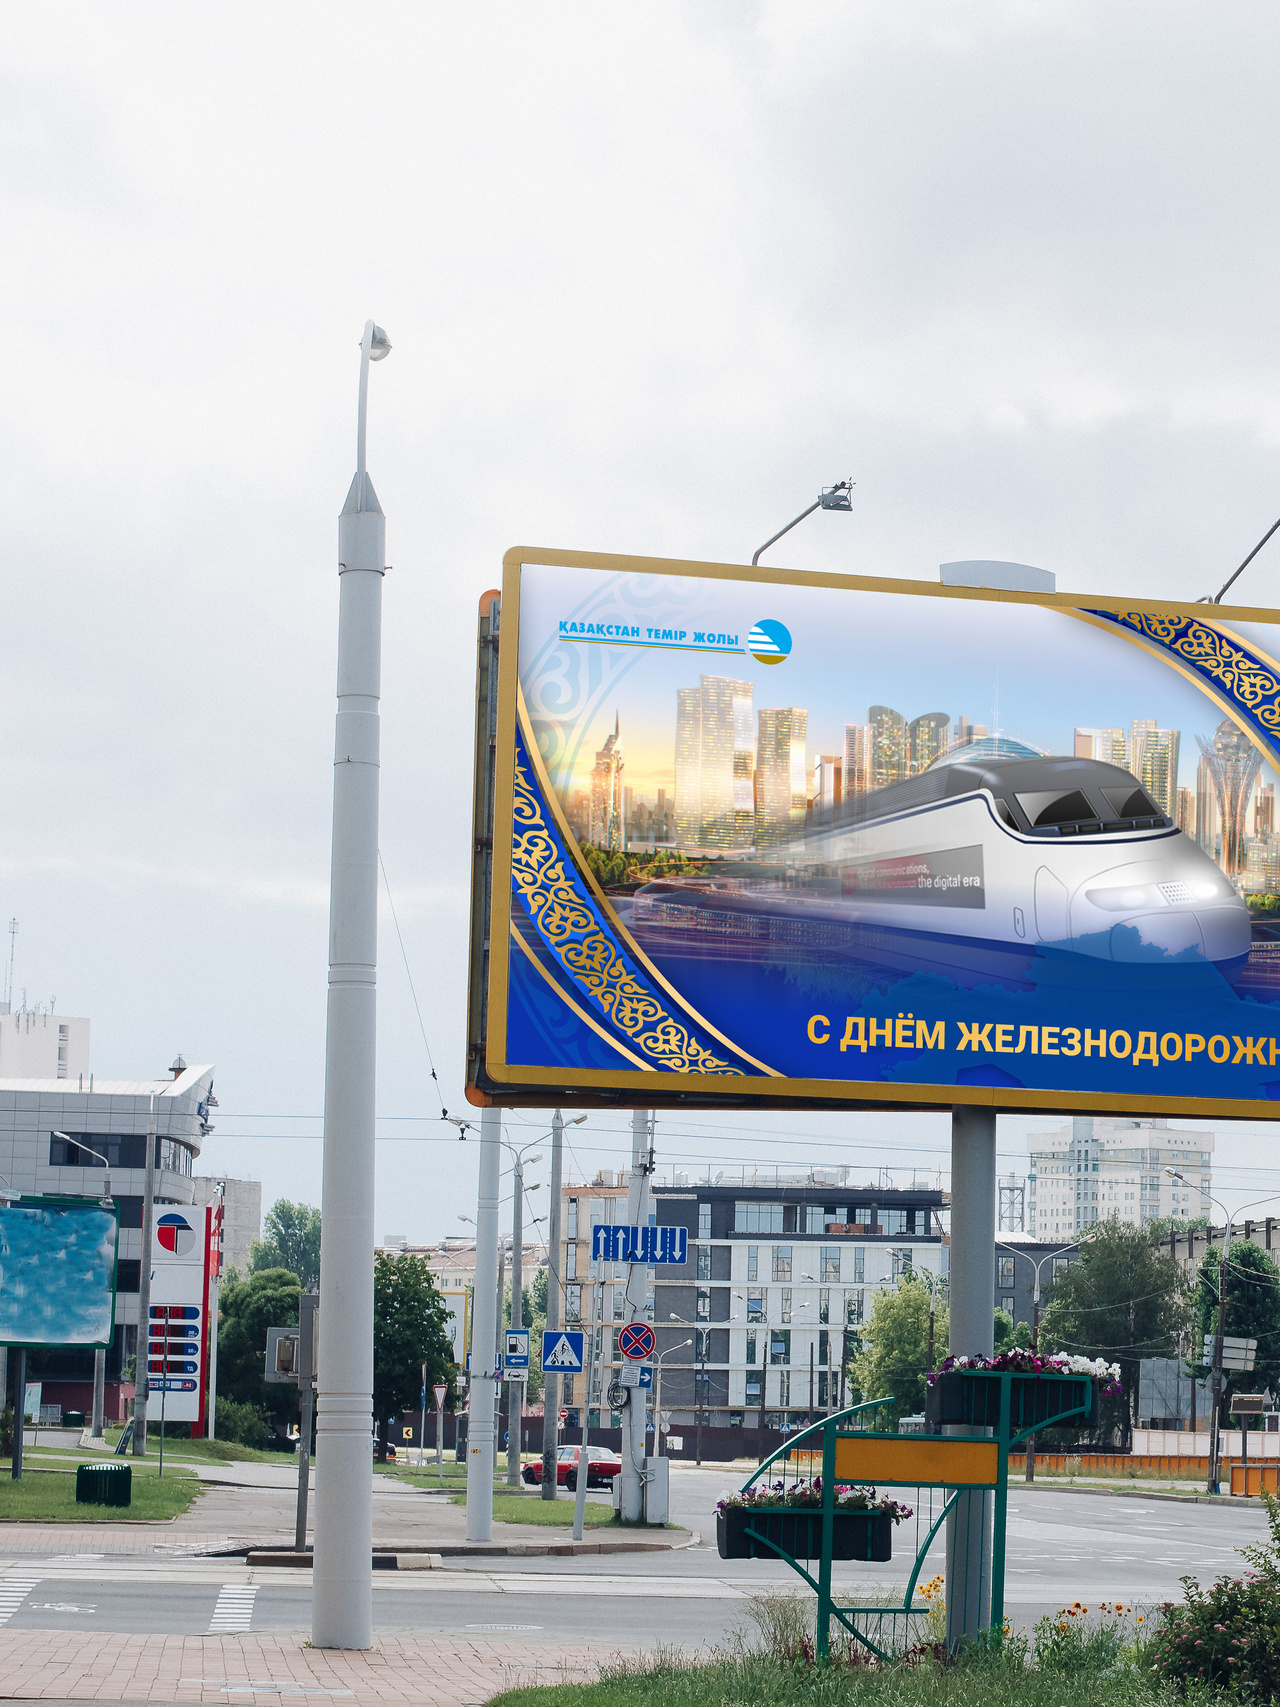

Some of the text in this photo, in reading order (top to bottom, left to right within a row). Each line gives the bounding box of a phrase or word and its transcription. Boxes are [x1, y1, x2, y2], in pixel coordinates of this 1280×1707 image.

[559, 620, 740, 646] ҚАЗАҚСТАН ТЕМІР ЖОЛЫ
[917, 875, 932, 889] the
[933, 874, 961, 891] digital
[962, 876, 981, 888] era
[806, 1014, 832, 1045] С
[839, 1012, 946, 1053] ДНЁМ
